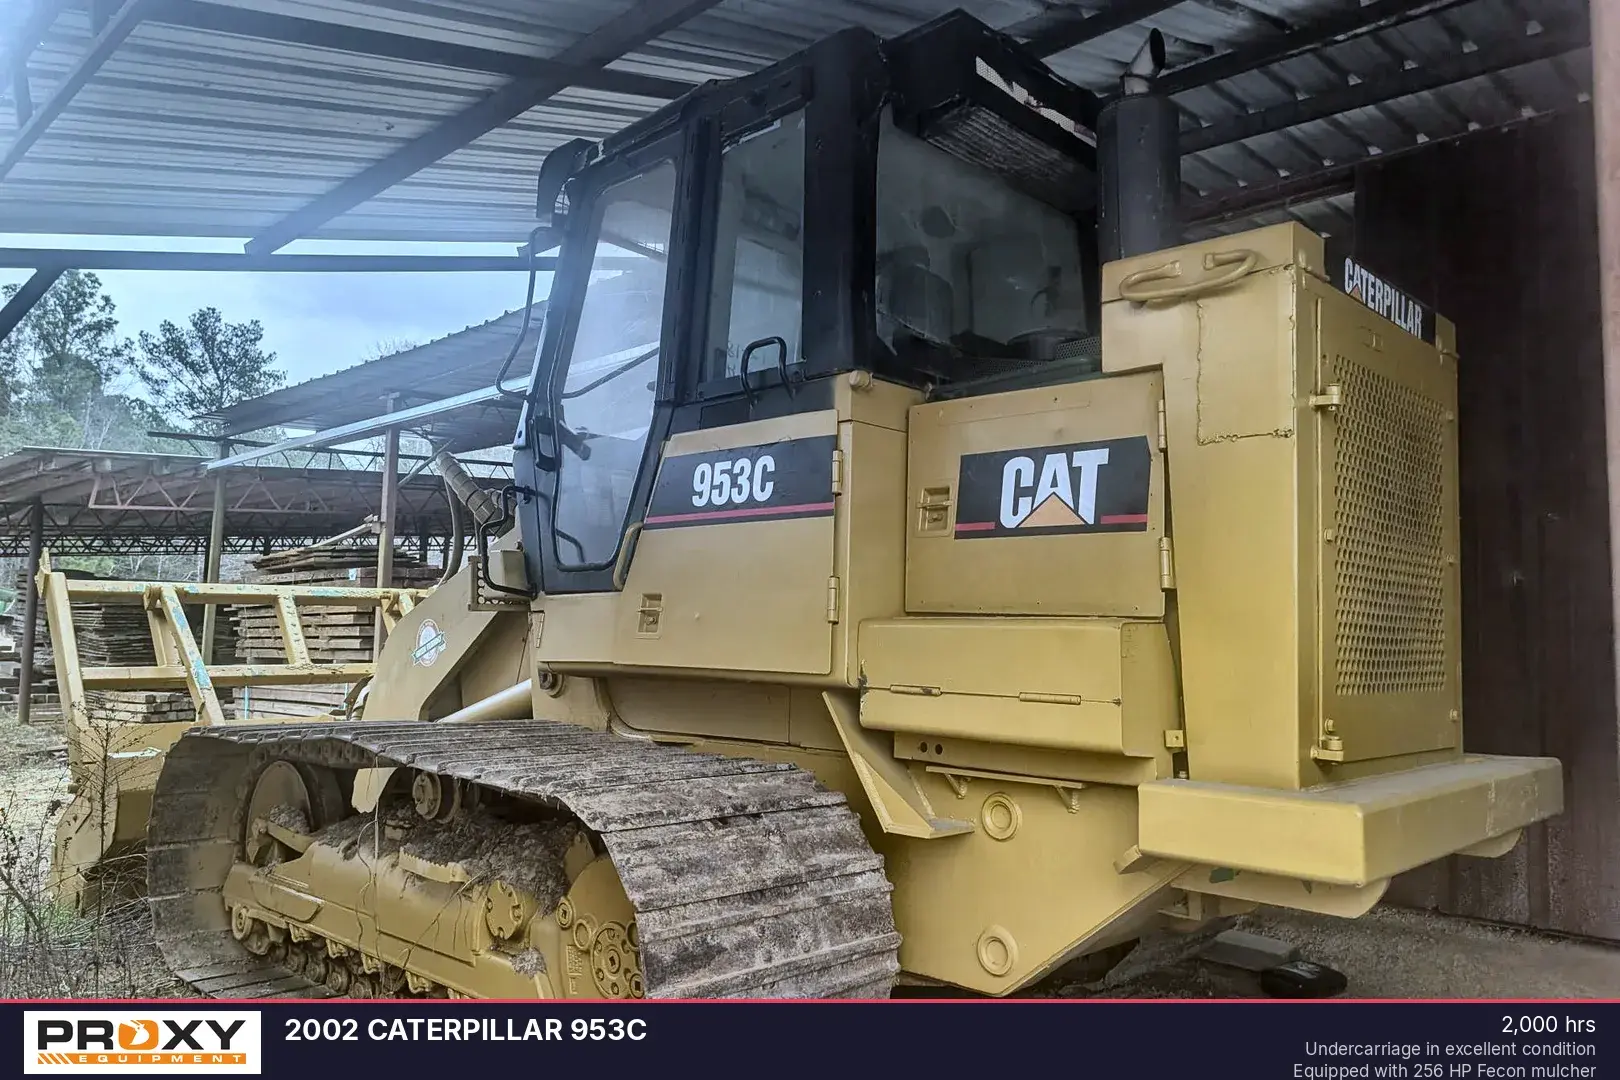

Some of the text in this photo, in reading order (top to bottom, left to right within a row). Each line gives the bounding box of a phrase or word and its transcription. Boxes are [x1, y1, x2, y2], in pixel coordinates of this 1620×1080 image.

[1344, 257, 1422, 340] CATERPILLAR
[692, 455, 775, 507] 953C
[1000, 448, 1110, 529] CAT
